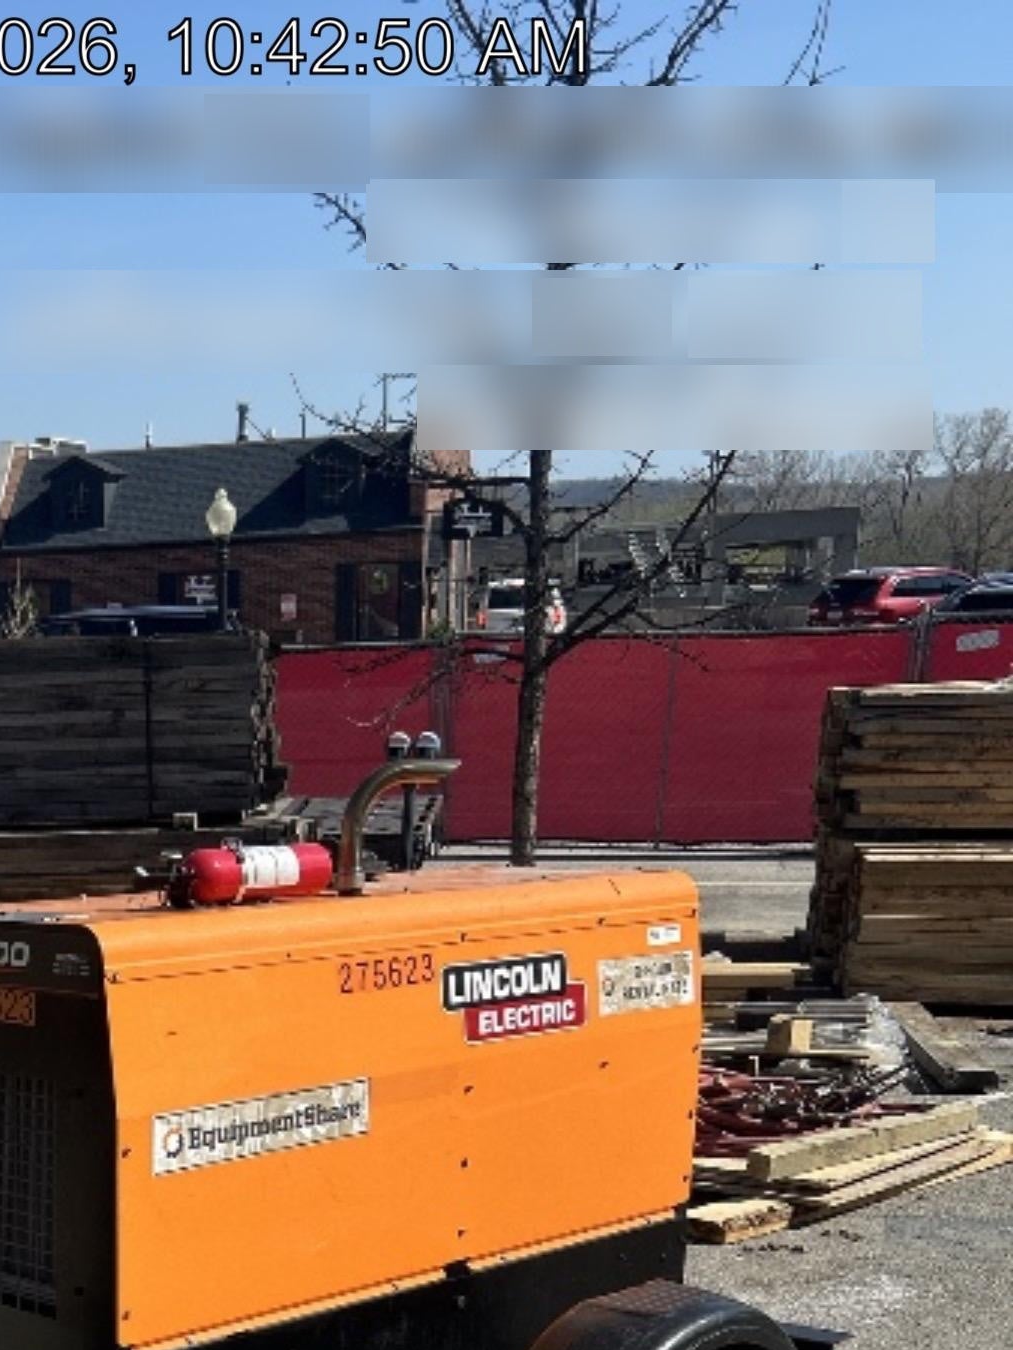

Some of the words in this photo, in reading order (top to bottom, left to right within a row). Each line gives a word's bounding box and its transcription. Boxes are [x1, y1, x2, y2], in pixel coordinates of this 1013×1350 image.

[338, 953, 434, 994] 275623
[448, 959, 562, 1005] LINCOLN
[478, 999, 576, 1036] ELECTRIC
[188, 1101, 361, 1151] EquipmentShare
